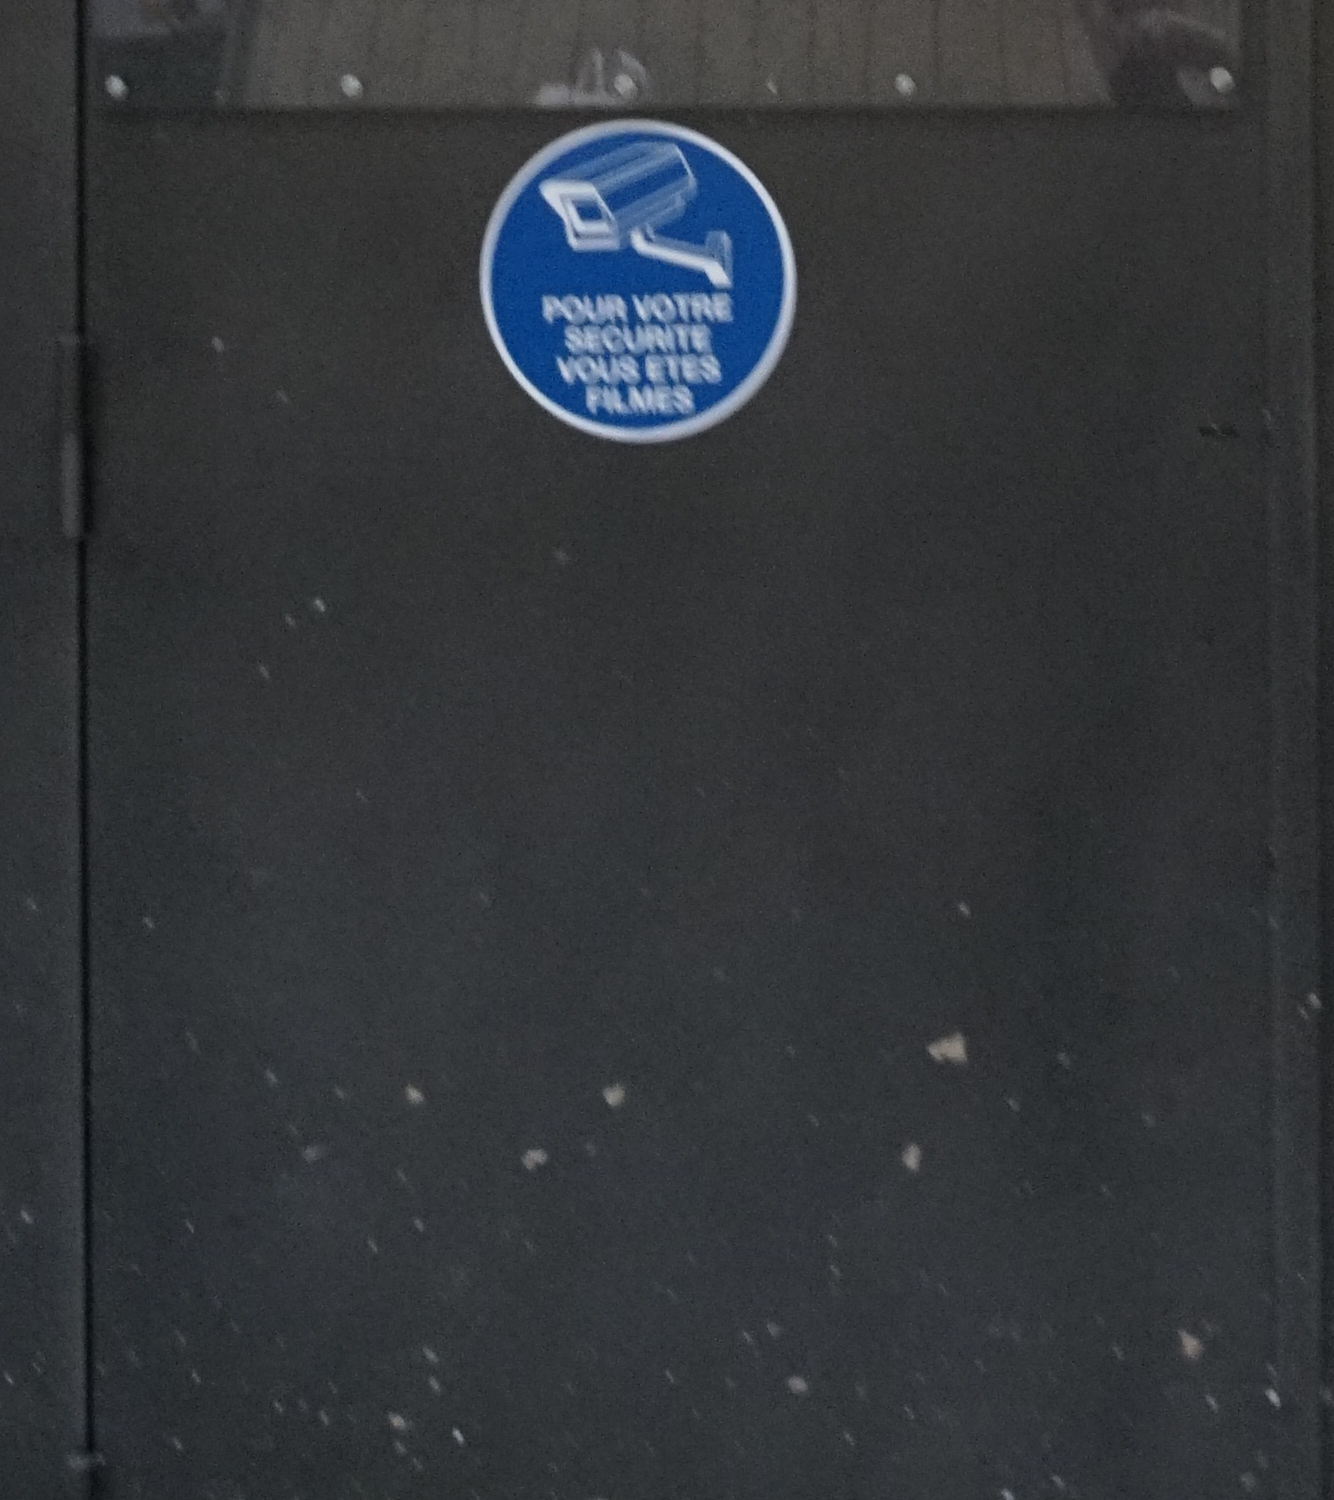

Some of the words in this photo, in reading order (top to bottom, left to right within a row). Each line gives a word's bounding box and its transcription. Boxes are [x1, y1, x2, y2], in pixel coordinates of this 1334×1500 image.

[542, 294, 628, 324] POUR
[632, 293, 733, 324] VOTRE
[556, 354, 641, 385] VOUS
